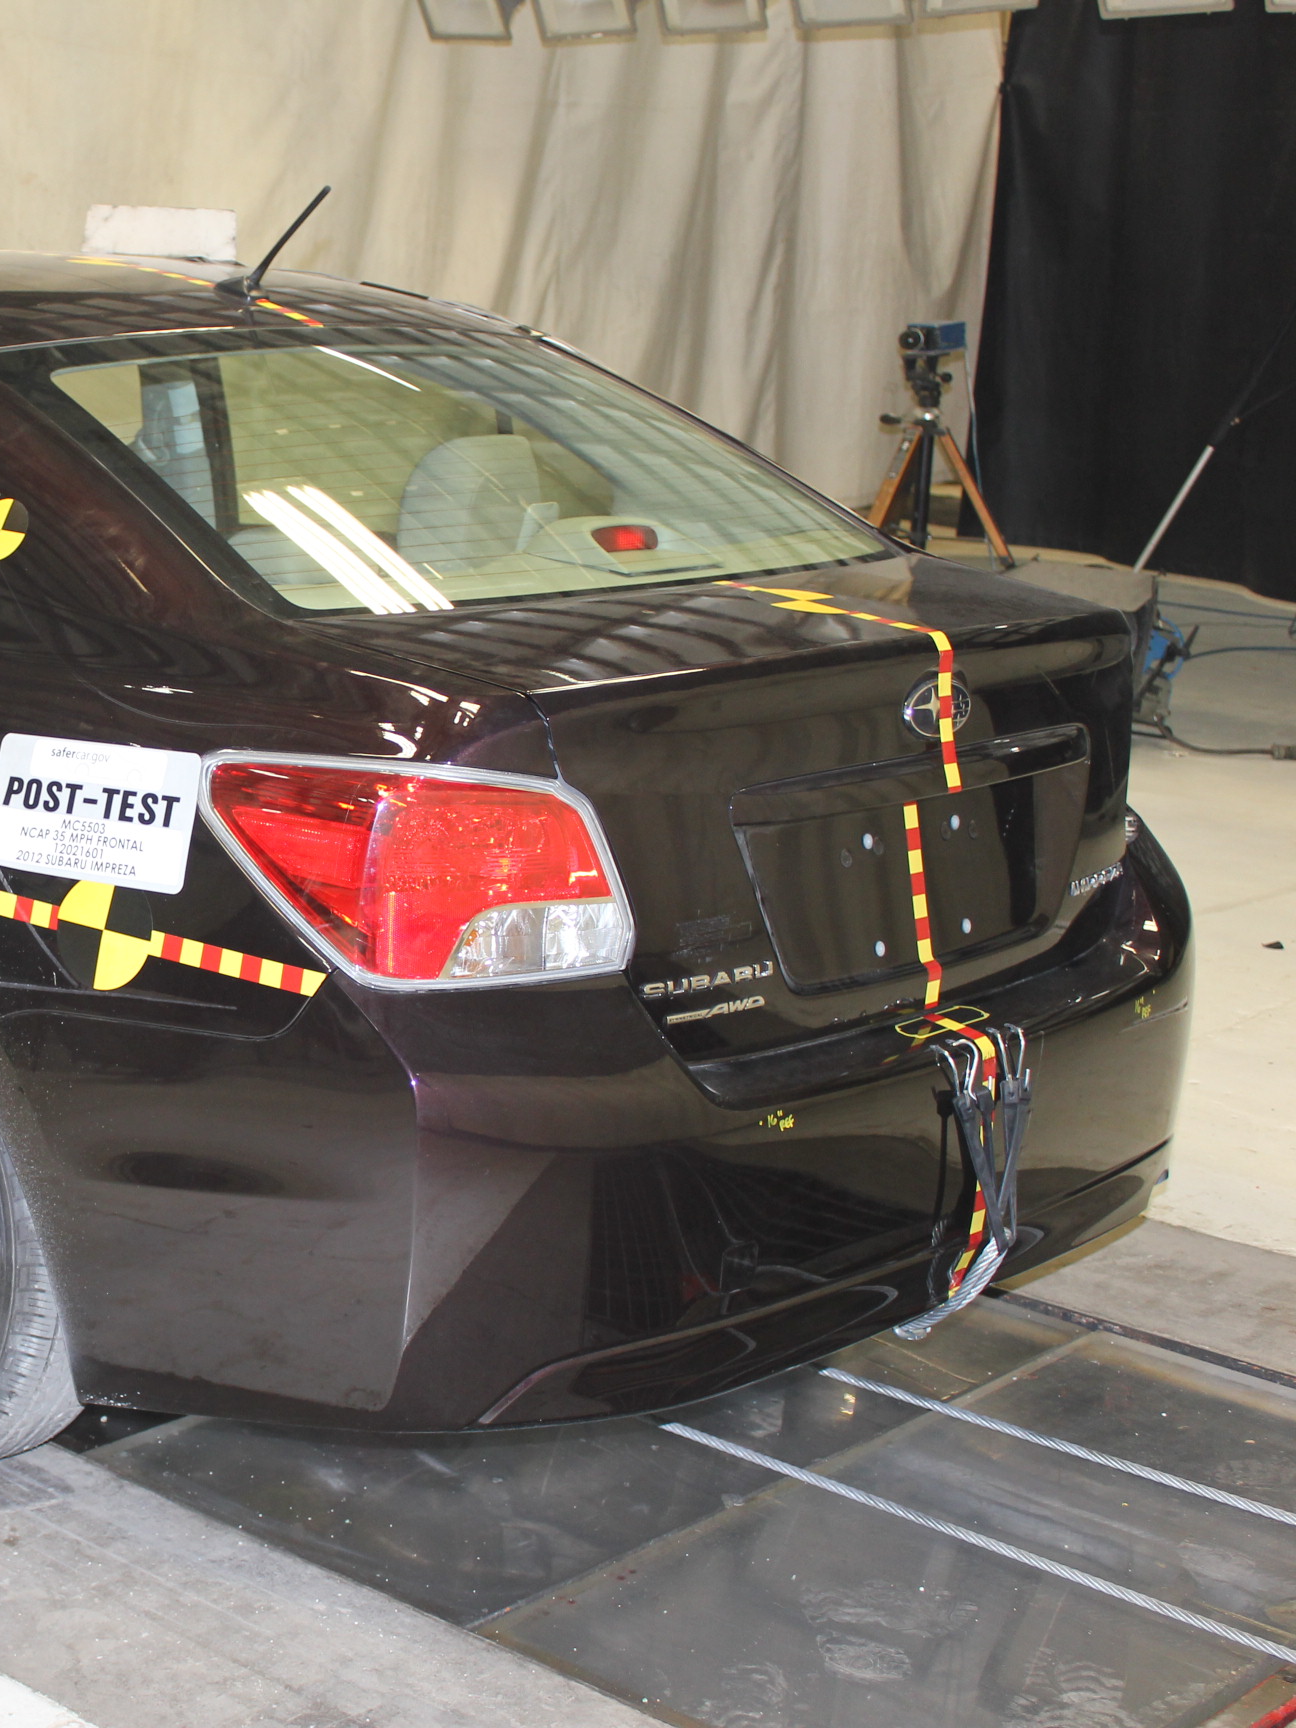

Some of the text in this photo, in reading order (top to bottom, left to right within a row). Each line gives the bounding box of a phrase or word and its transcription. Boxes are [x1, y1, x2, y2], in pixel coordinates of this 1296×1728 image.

[51, 747, 111, 764] safercar.gov
[2, 775, 181, 828] POST-TEST
[60, 818, 107, 835] MC5503
[20, 826, 144, 852] NCAP 35 MPH FRONTAL
[54, 843, 105, 859] 12021601
[15, 850, 137, 877] 2012 SUBARU IMPREZA
[639, 960, 774, 1000] SUBARU
[705, 995, 766, 1018] AWD
